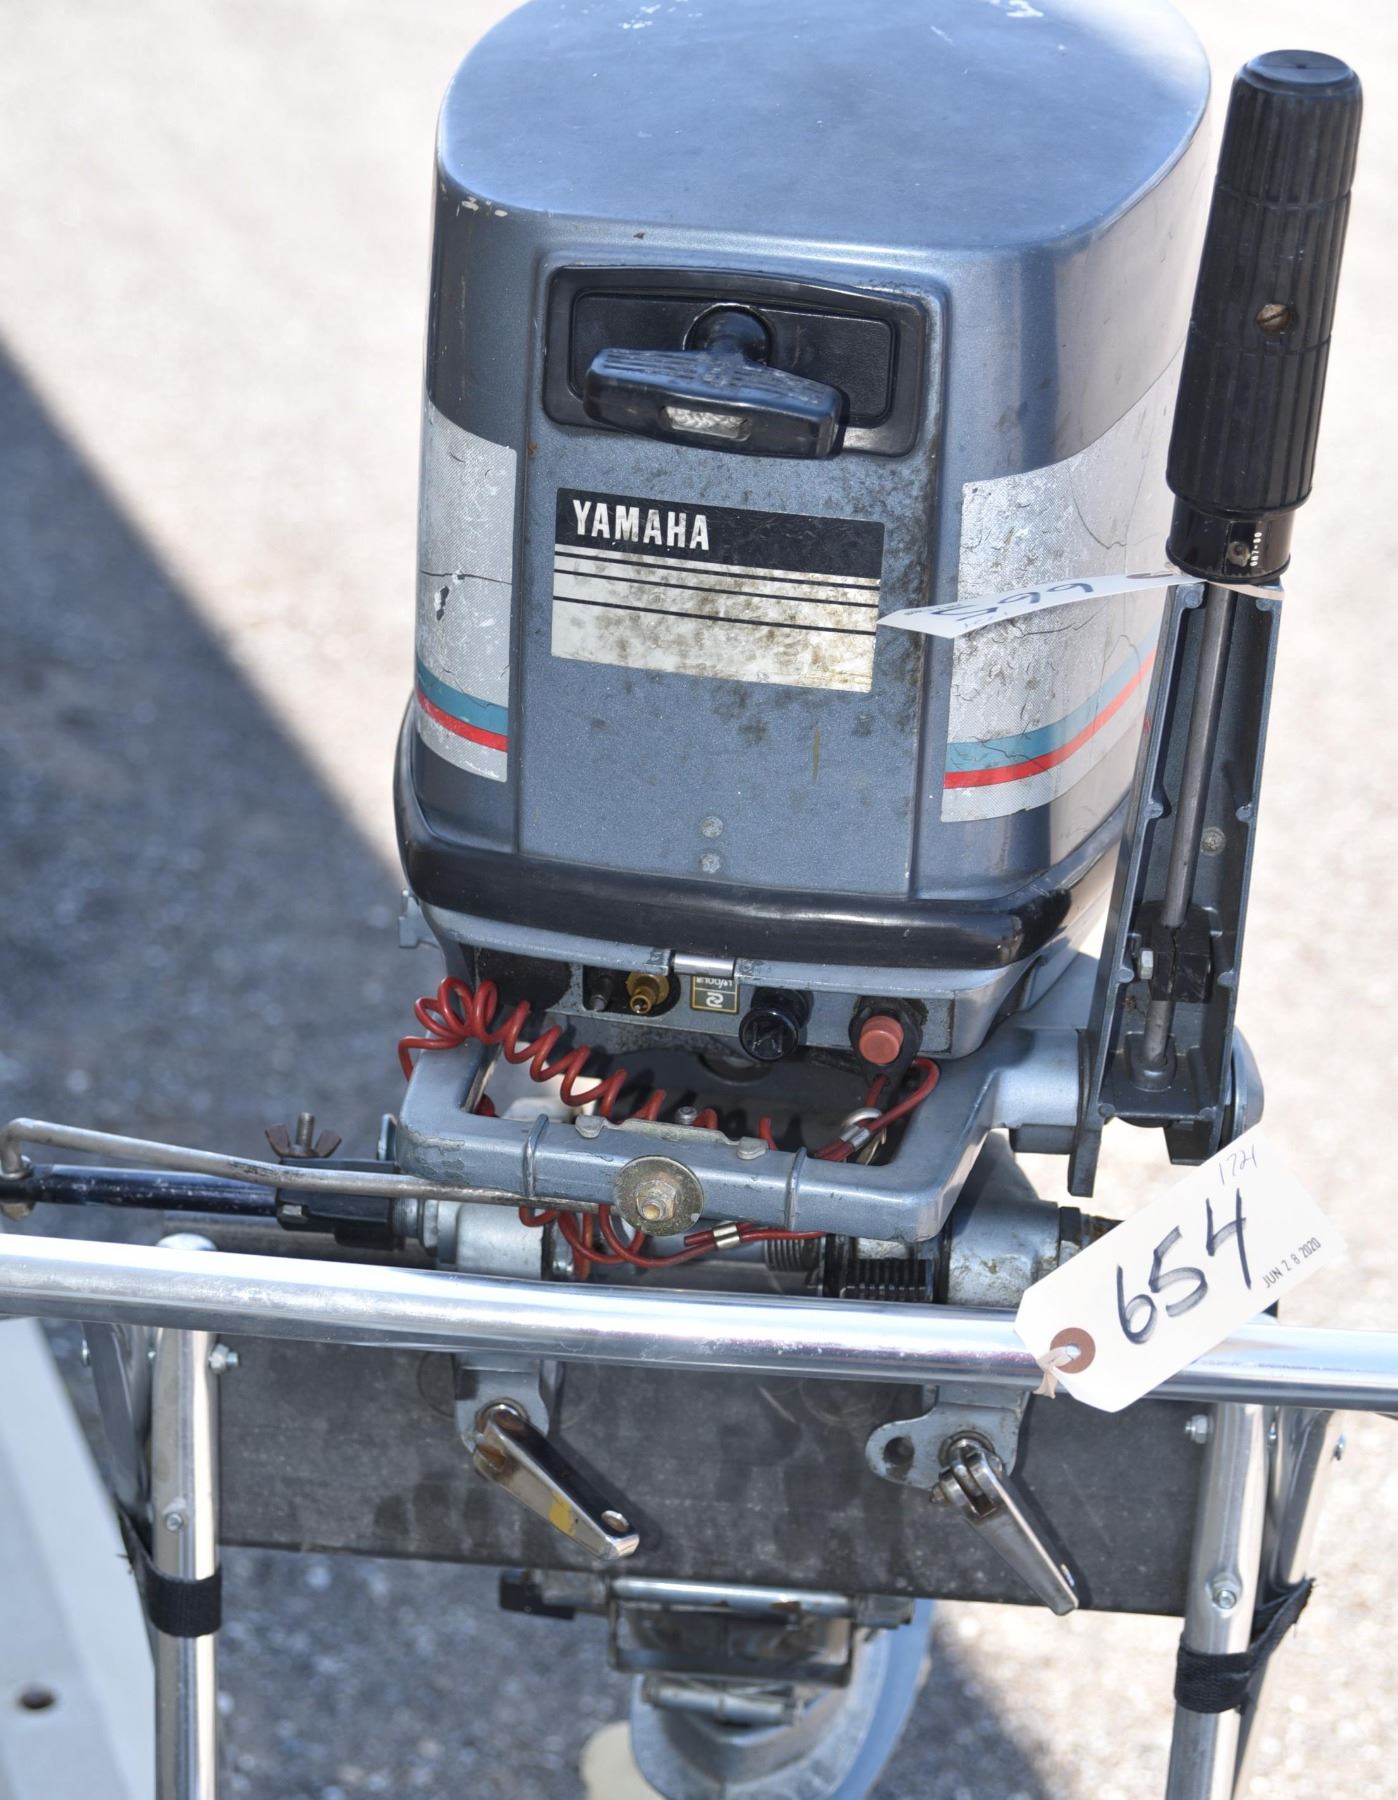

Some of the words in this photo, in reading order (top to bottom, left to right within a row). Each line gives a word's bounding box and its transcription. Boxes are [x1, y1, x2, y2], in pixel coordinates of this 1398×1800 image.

[573, 499, 709, 551] YAMAHA
[1116, 1187, 1252, 1345] 654
[1262, 1266, 1283, 1288] JUN
[1298, 1237, 1321, 1258] 2020
